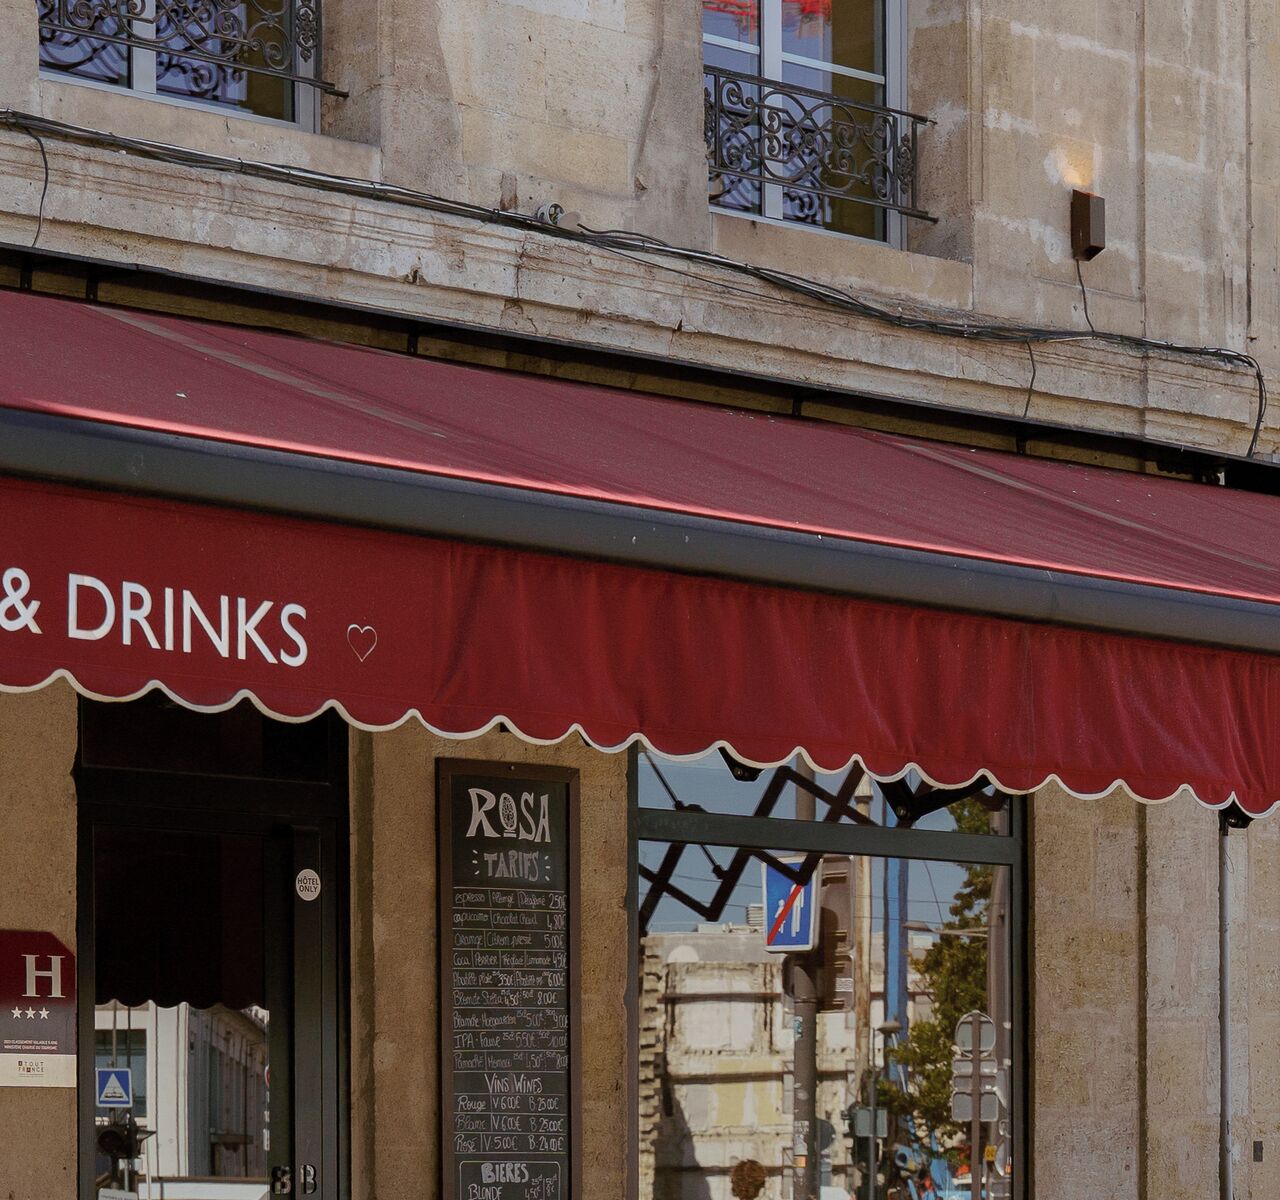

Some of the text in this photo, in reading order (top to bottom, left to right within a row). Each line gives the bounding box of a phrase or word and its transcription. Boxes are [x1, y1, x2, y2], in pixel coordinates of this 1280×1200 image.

[67, 573, 309, 667] DRINKS
[465, 788, 552, 843] ROSA
[483, 850, 540, 882] TARIFS
[299, 884, 319, 893] ONLY
[453, 952, 471, 966] Coca
[20, 953, 67, 999] H
[453, 1032, 475, 1049] IPA
[457, 1095, 487, 1113] Rouge
[454, 1134, 478, 1153] Rosé
[481, 1162, 530, 1184] BIERES
